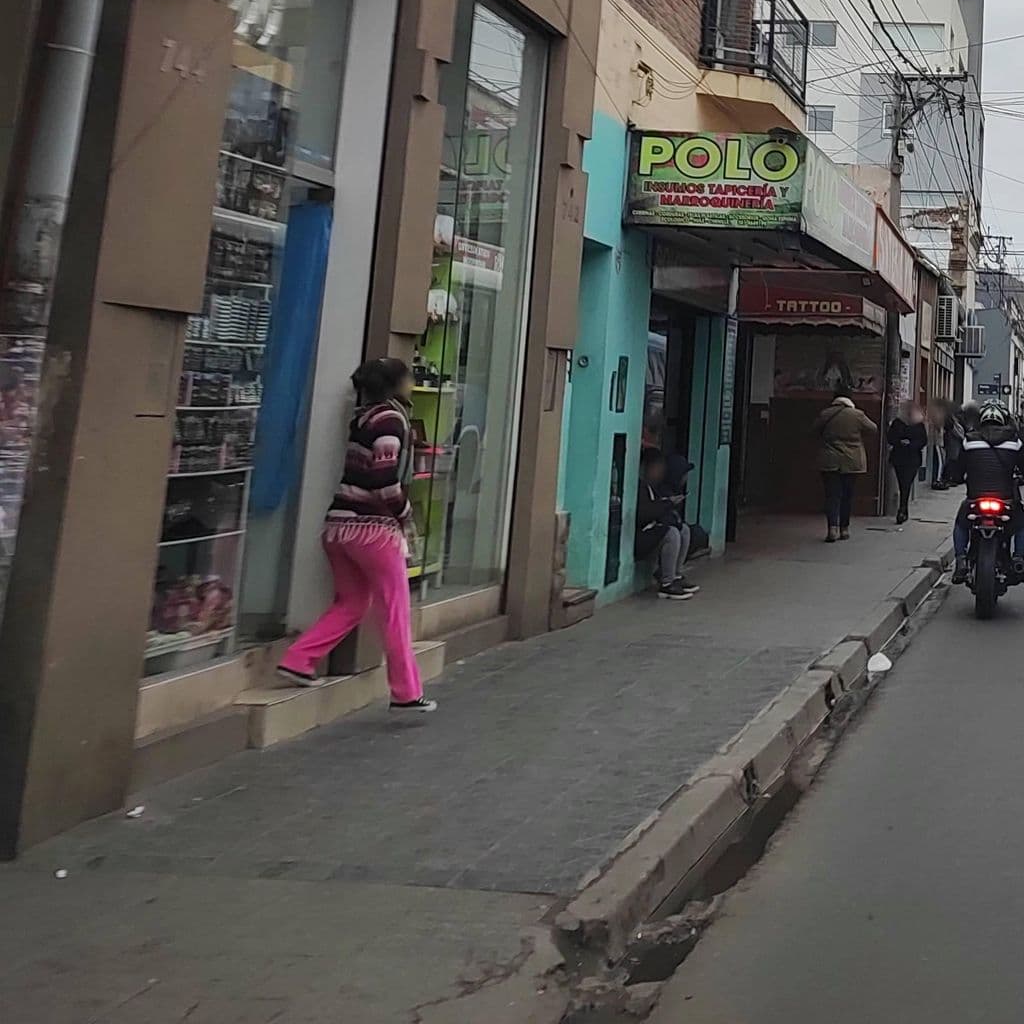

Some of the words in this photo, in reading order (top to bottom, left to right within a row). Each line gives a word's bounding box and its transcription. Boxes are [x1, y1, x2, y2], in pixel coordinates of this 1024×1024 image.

[638, 135, 801, 183] POLO
[643, 181, 706, 195] INSUMOS
[779, 187, 790, 198] Y
[776, 299, 842, 313] TATTOO
